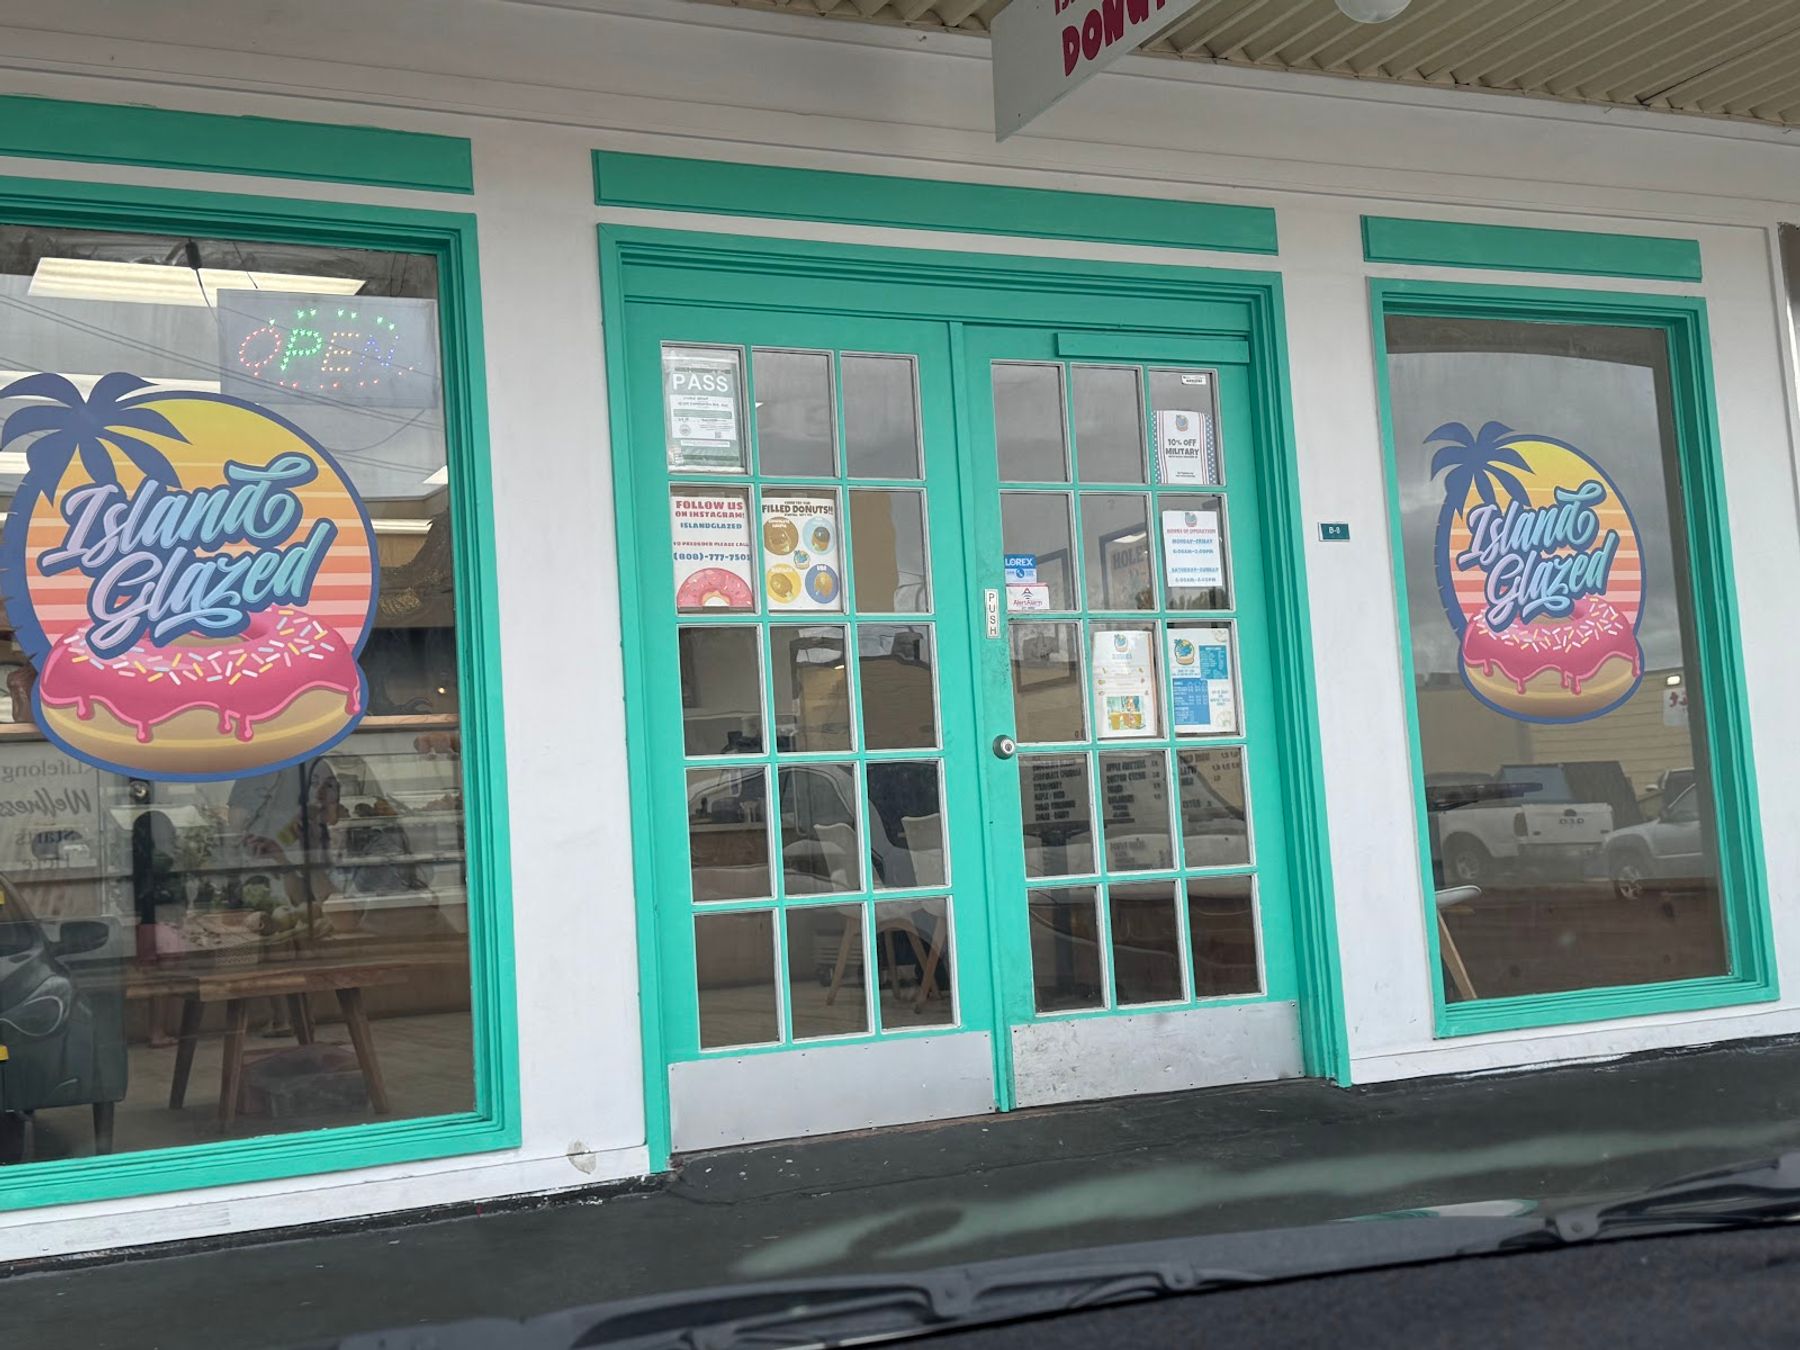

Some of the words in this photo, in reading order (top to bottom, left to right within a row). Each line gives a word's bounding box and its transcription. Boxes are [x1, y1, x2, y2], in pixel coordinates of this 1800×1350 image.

[1062, 0, 1166, 76] DONU
[239, 327, 398, 373] OPEN
[672, 373, 729, 392] PASS
[1165, 447, 1200, 456] MILITARY
[1183, 439, 1197, 447] OFF
[41, 456, 313, 568] Island
[675, 510, 688, 518] ON
[676, 500, 724, 510] FOLLOW
[727, 501, 744, 511] US
[762, 504, 791, 514] FILLED
[680, 522, 743, 530] ISLANDGLAZED
[1457, 482, 1603, 564] Island
[1005, 558, 1033, 567] LOREX
[90, 522, 329, 650] Glazed
[1486, 532, 1616, 625] Glazed
[988, 592, 997, 635] PUSH
